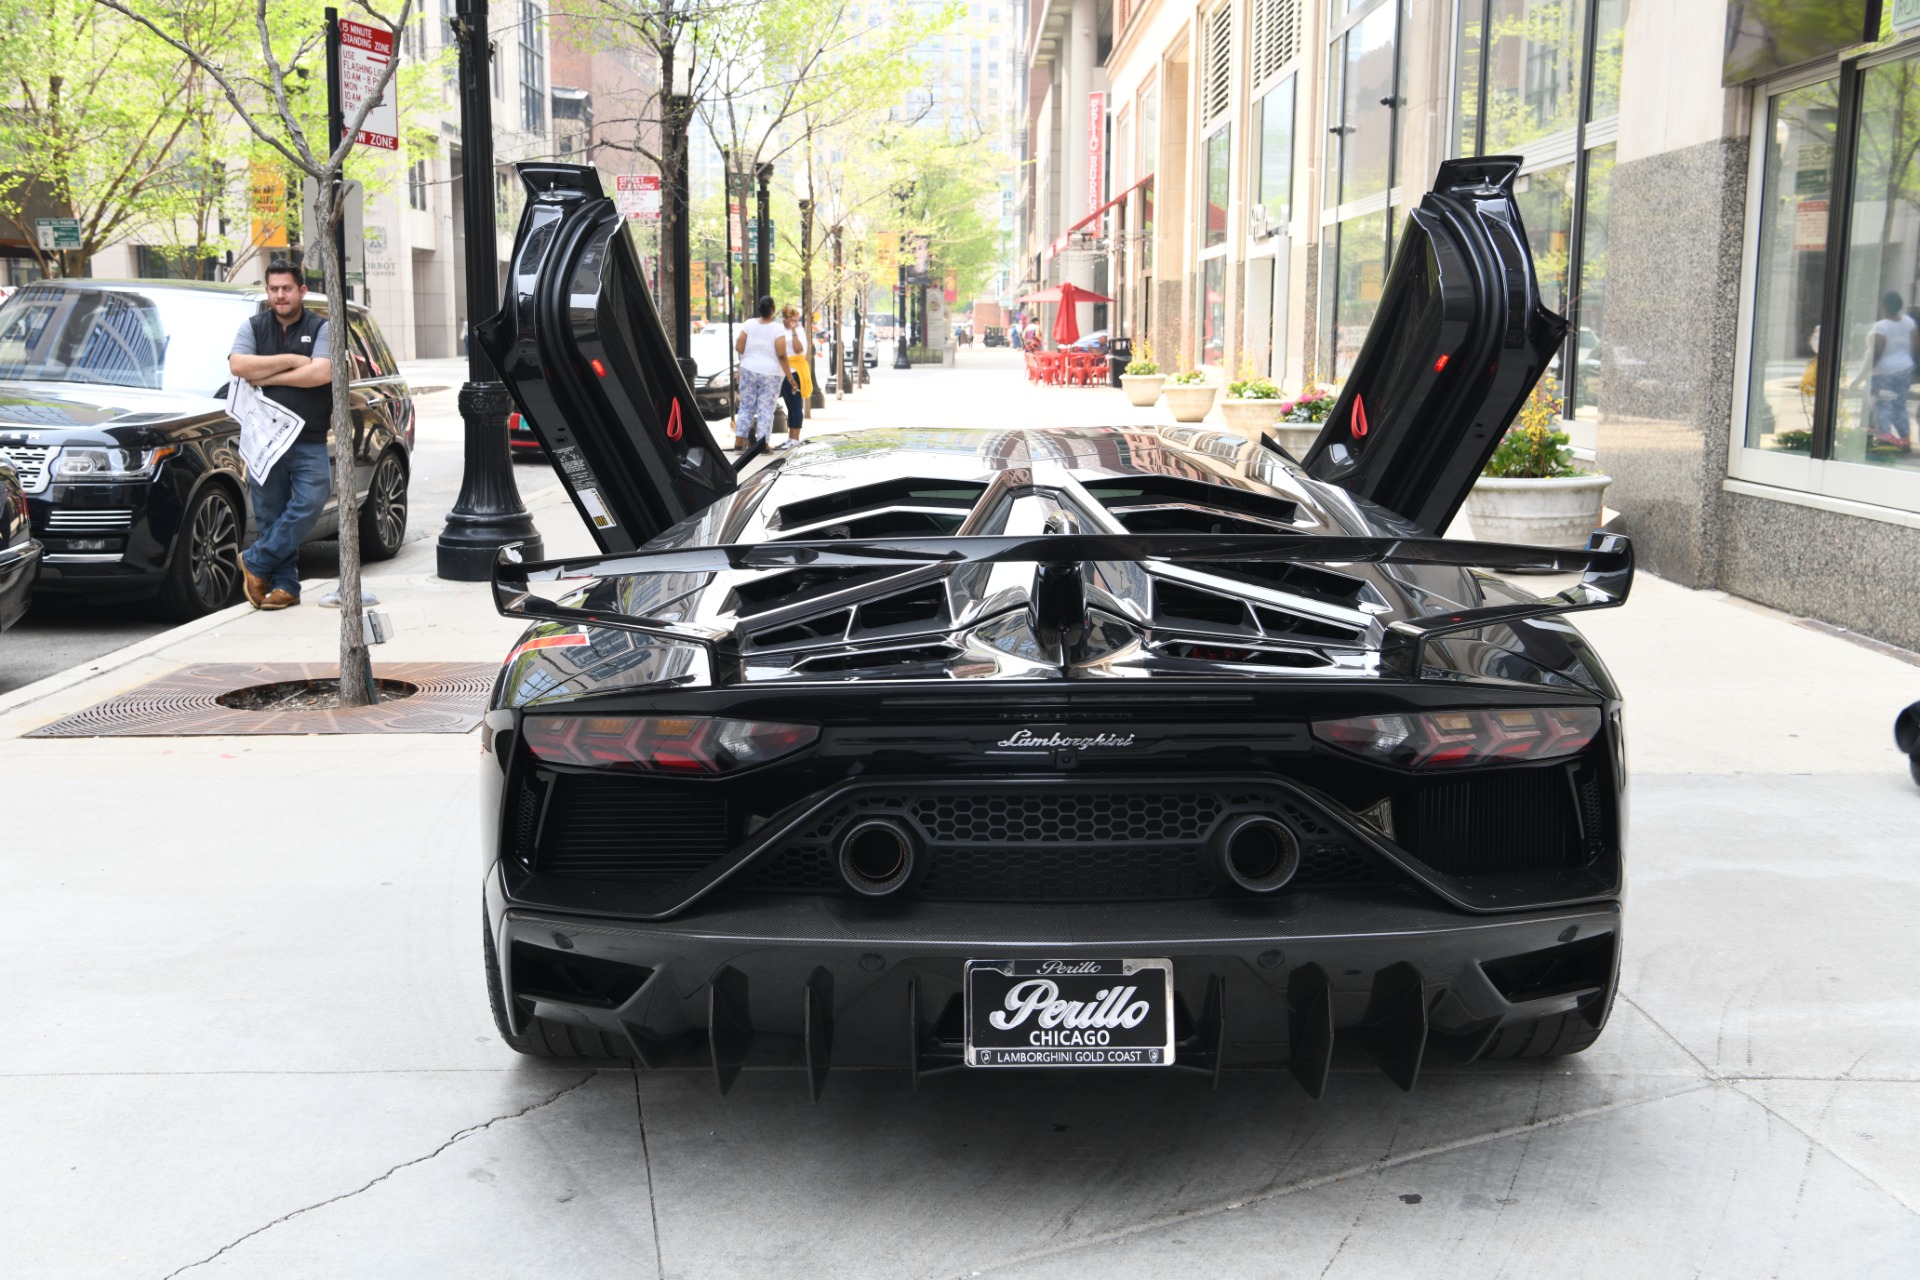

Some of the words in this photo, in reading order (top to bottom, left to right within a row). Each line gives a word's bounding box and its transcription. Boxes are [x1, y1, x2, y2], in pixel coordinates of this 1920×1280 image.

[342, 22, 349, 32] 15
[350, 25, 373, 39] MINUTE
[342, 33, 372, 49] STANDING
[374, 41, 390, 54] ZONE
[343, 50, 355, 60] USE
[343, 60, 373, 75] FLASHING
[344, 81, 358, 91] MON
[1089, 99, 1099, 151] EPIC
[370, 134, 395, 149] ZONE
[997, 728, 1136, 750] Lamborghini
[1036, 960, 1102, 975] Perillo
[989, 978, 1150, 1031] Perillo
[1029, 1030, 1111, 1046] CHICAGO
[997, 1050, 1073, 1063] LAMBORGHINI
[1074, 1050, 1105, 1062] GOLD
[1107, 1050, 1143, 1062] COAST
